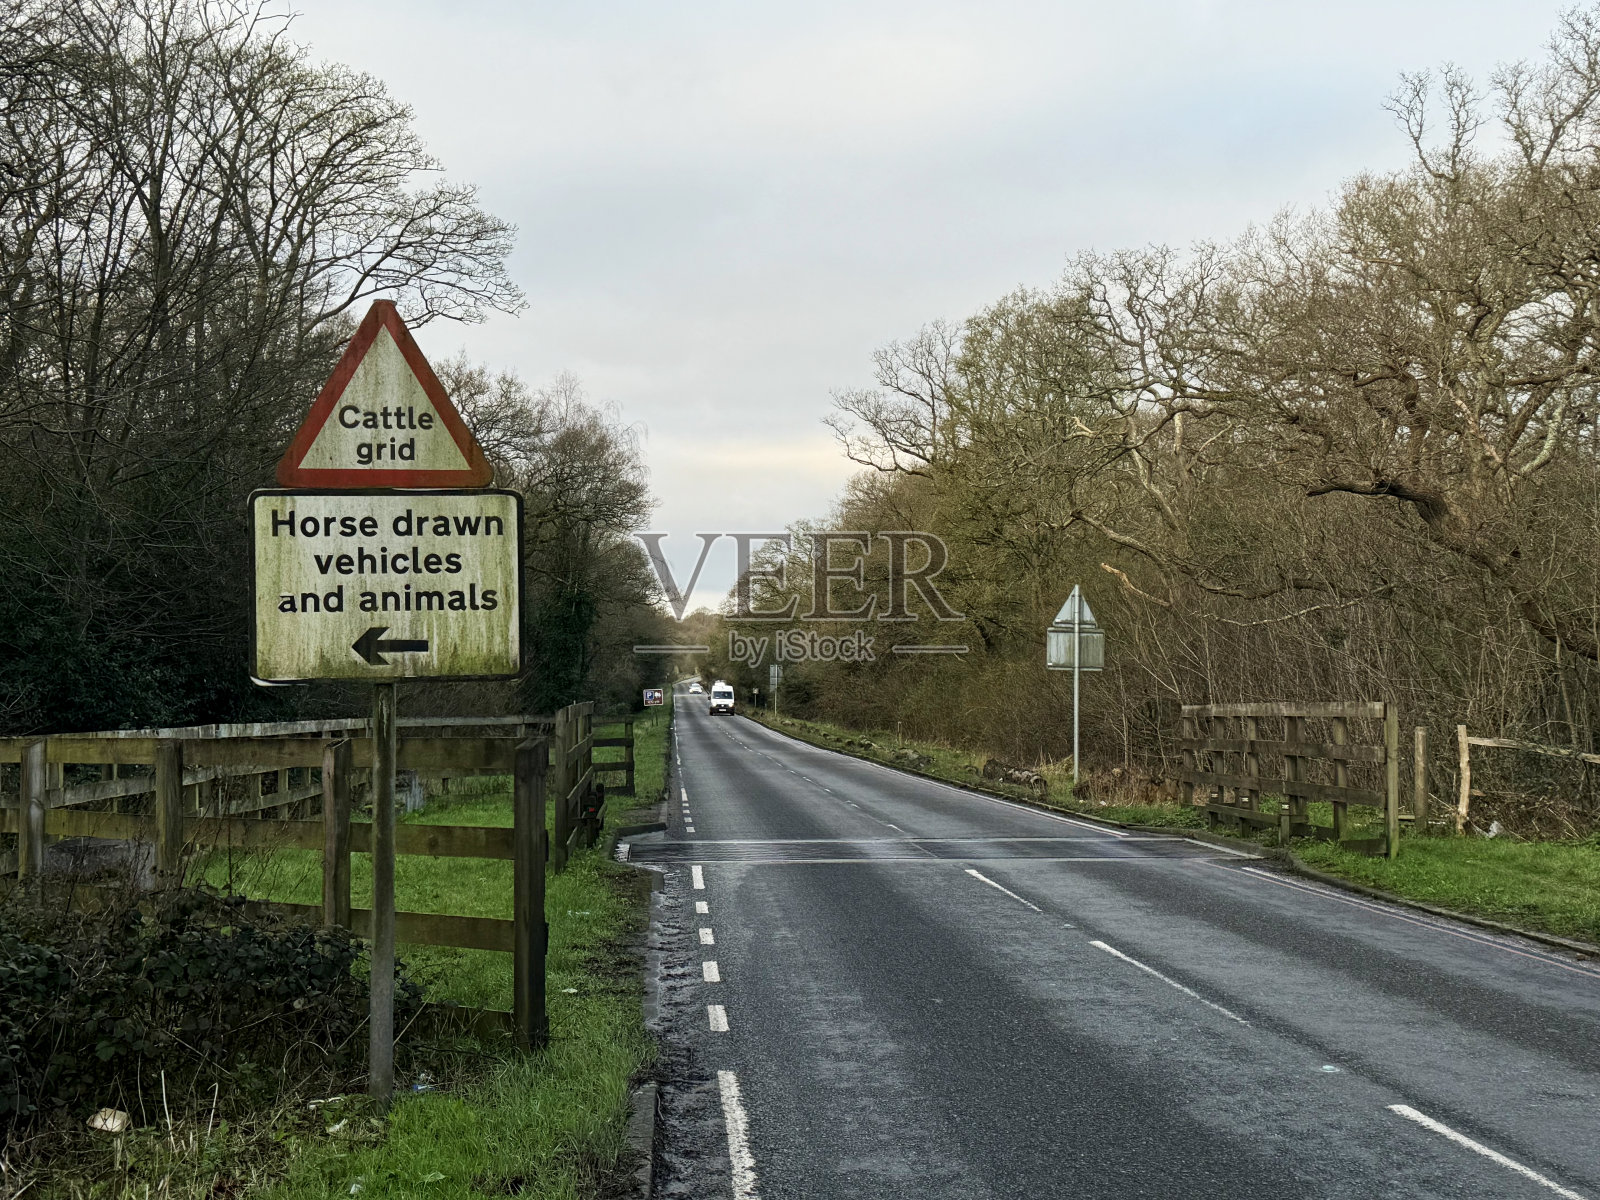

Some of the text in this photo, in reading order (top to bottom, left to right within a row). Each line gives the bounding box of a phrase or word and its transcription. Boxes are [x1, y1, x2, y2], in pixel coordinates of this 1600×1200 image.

[338, 405, 434, 429] Cattle
[356, 437, 415, 464] grid
[271, 509, 504, 537] Horse drawn
[314, 547, 462, 574] vehicles
[278, 583, 498, 613] and animals
